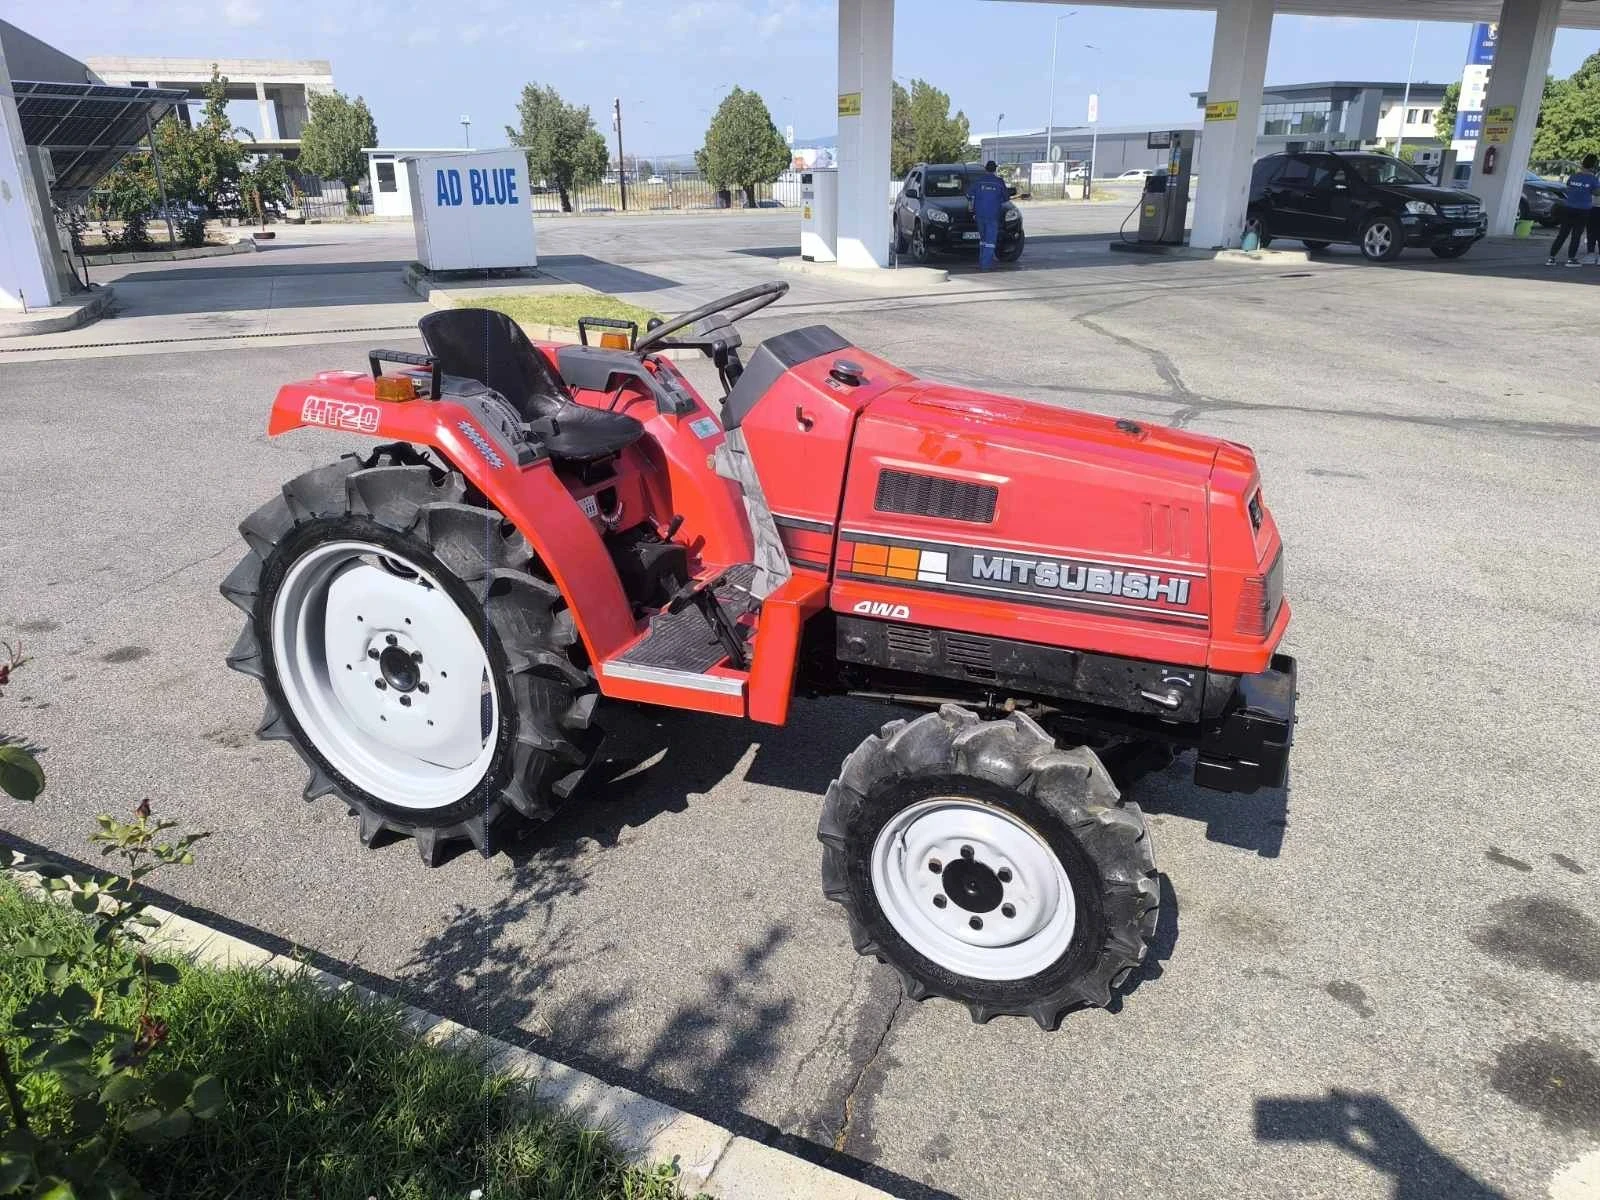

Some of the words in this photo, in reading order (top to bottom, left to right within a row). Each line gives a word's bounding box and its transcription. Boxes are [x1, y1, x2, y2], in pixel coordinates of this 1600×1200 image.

[437, 169, 463, 206] AD
[469, 168, 519, 205] BLUE
[301, 395, 380, 433] MT20
[972, 554, 1190, 605] MITSUBISHI
[853, 600, 910, 619] 4WD
